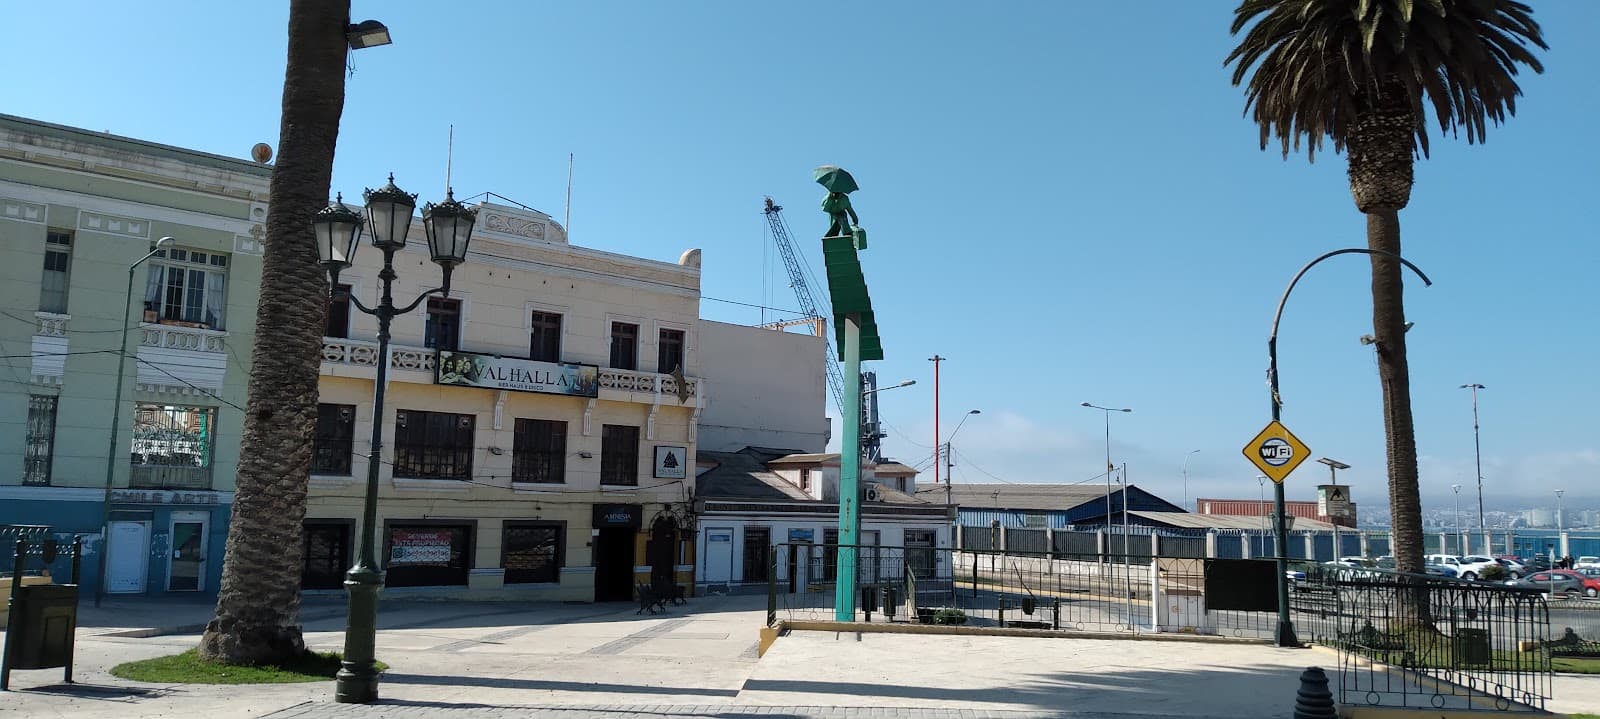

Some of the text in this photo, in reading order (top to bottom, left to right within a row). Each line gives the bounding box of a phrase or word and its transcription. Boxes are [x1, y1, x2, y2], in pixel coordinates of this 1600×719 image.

[474, 364, 569, 388] VALHALLA
[111, 491, 218, 504] CHILE ARTE
